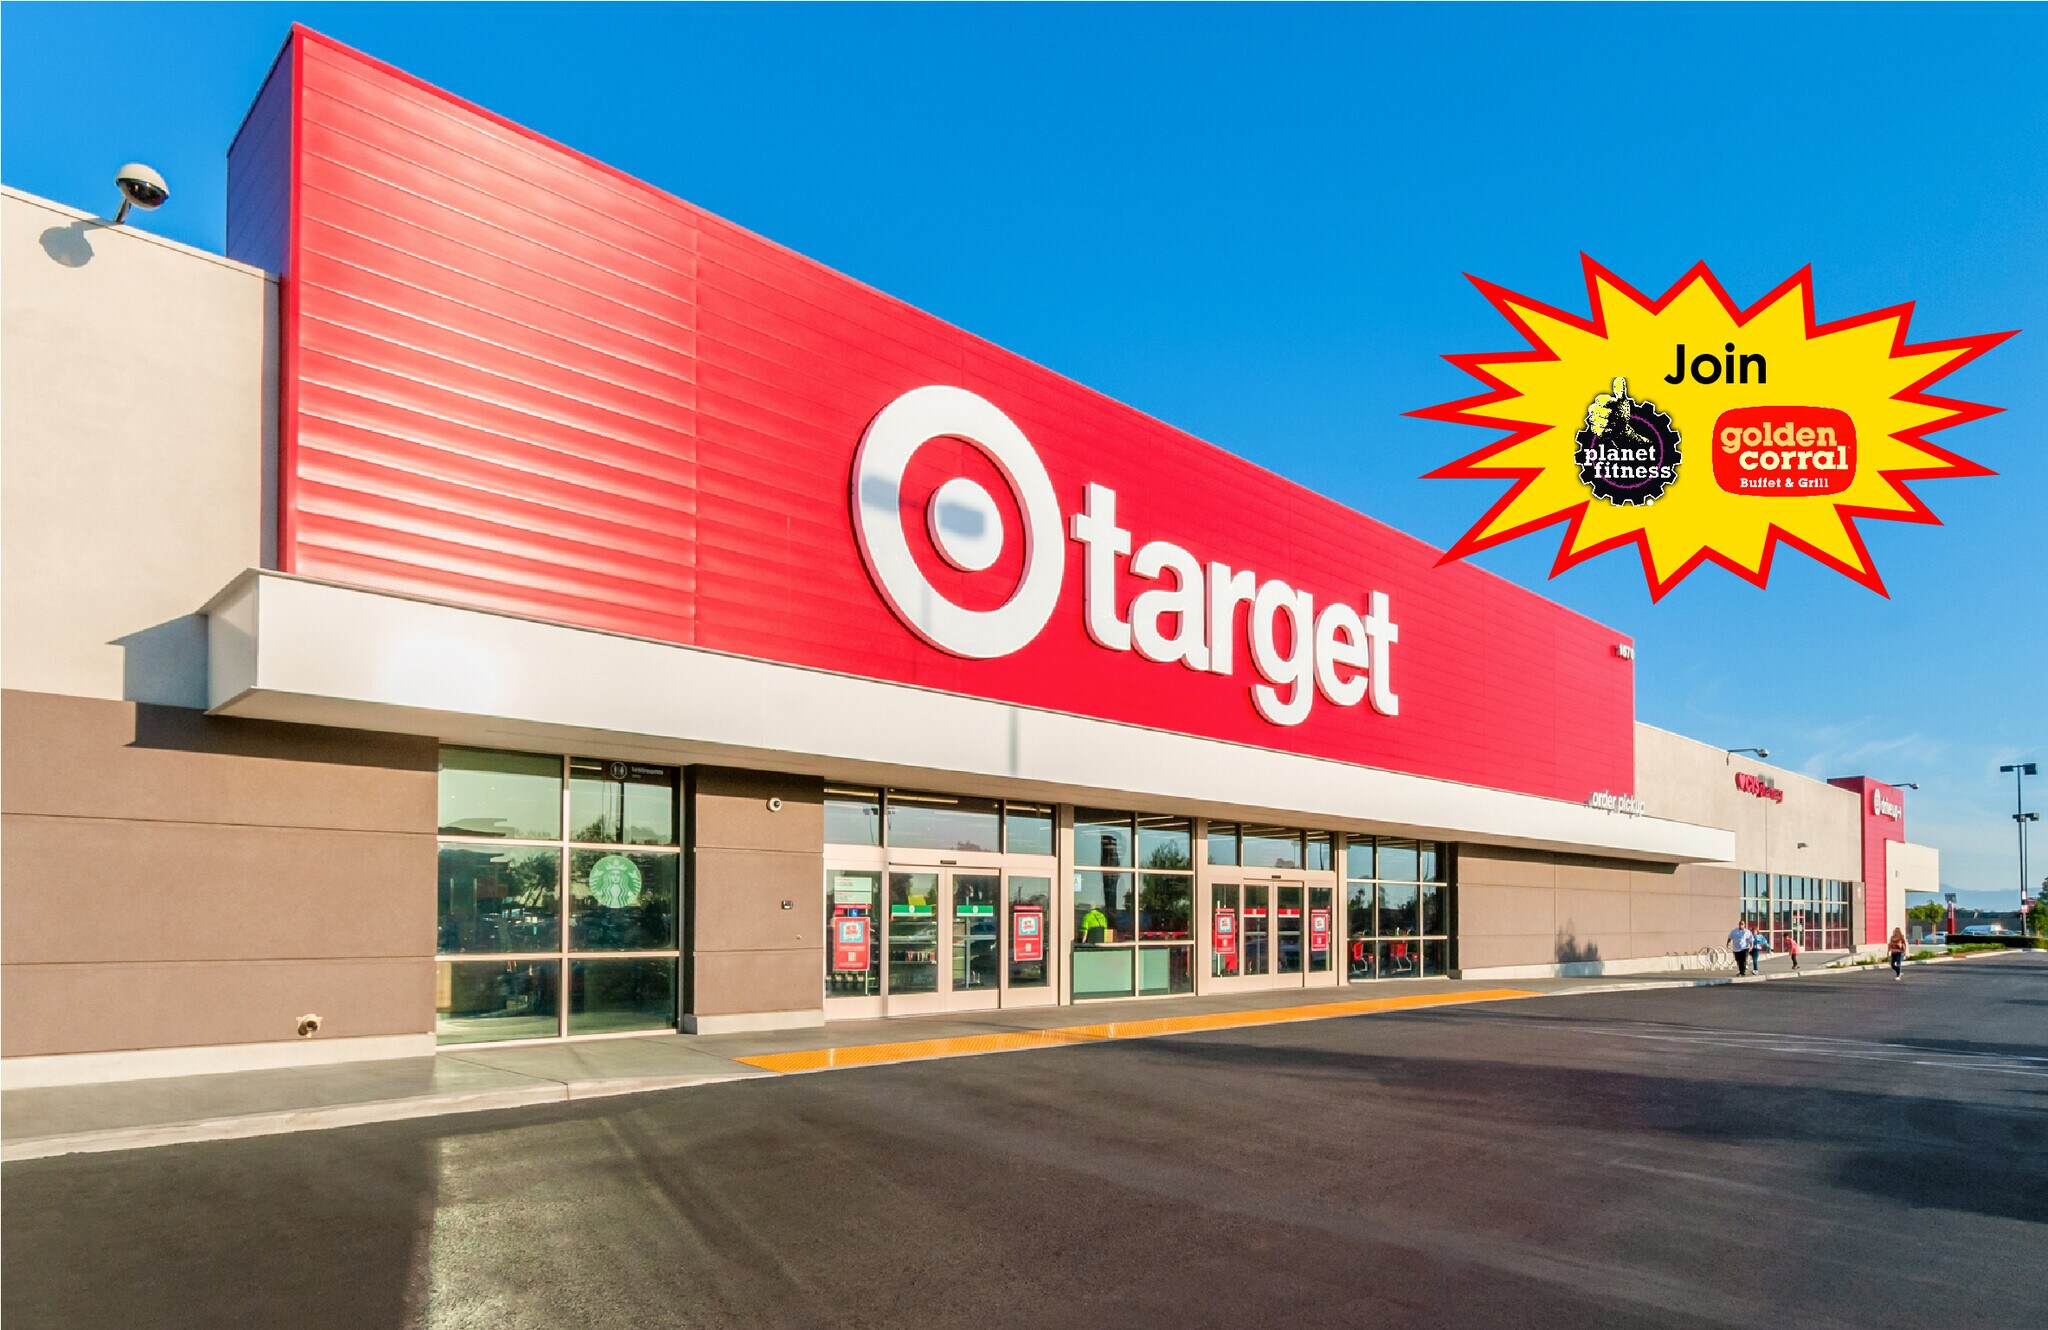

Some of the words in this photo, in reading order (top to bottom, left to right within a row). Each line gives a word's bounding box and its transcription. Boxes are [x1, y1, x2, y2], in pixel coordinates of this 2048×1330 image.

[1069, 481, 1399, 727] target
[1592, 789, 1617, 810] order
[1618, 792, 1645, 818] pickup
